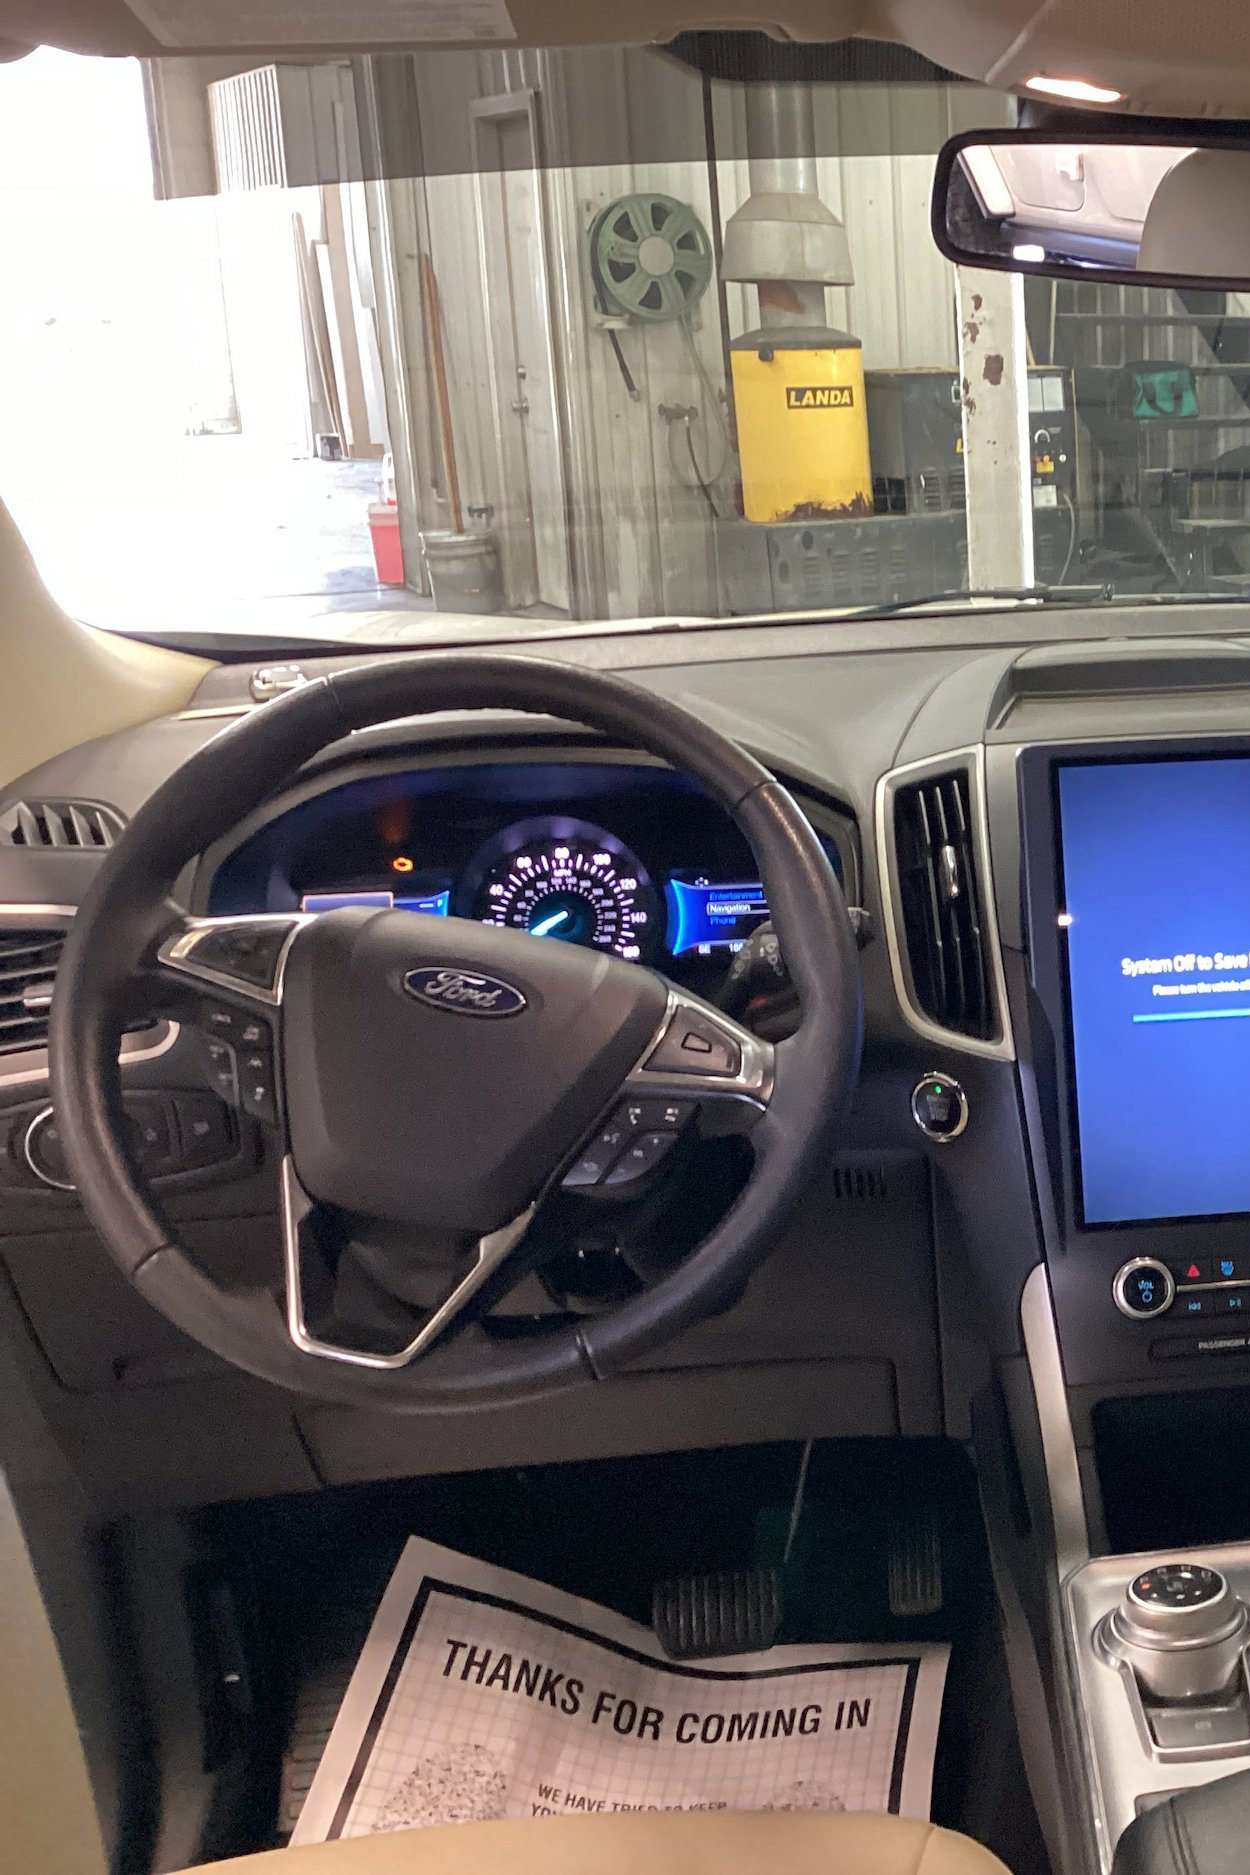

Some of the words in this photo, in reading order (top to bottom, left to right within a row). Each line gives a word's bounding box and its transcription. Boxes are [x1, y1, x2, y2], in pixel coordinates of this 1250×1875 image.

[790, 388, 851, 406] LANDA
[620, 878, 637, 890] 120
[630, 911, 647, 923] 140
[709, 904, 751, 914] Navigation
[1121, 958, 1172, 977] System
[1174, 954, 1195, 972] Off
[1197, 955, 1213, 970] to
[1214, 952, 1248, 969] Save
[425, 972, 502, 1007] Ford
[443, 1639, 584, 1715] THANKS
[592, 1691, 664, 1741] FOR
[676, 1705, 822, 1744] COMING
[835, 1698, 871, 1731] IN
[538, 1783, 562, 1803] WE
[564, 1793, 606, 1812] HAVE
